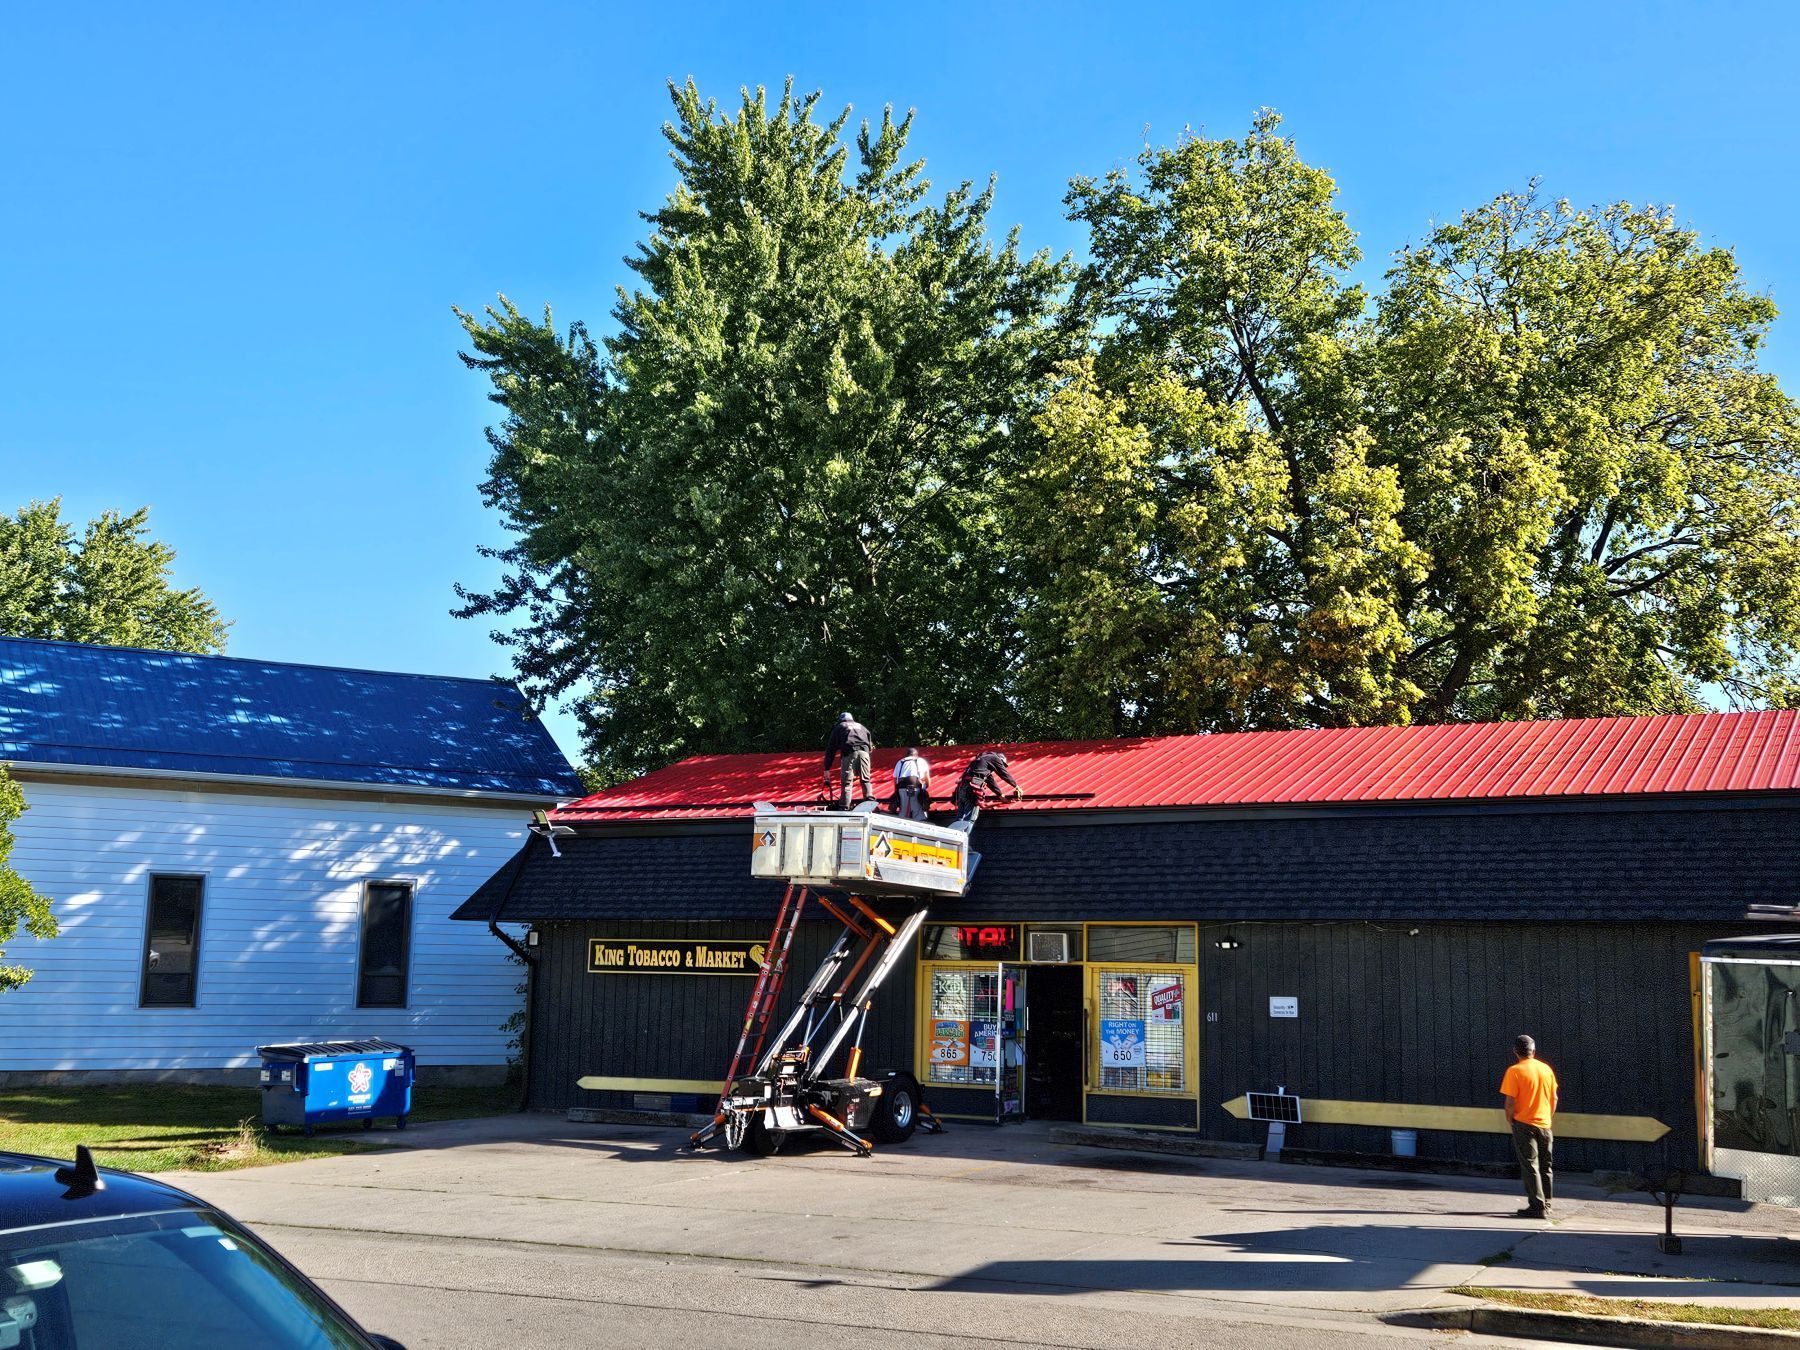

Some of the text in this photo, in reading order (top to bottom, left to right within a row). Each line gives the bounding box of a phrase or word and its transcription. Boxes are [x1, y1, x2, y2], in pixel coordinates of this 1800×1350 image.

[627, 945, 680, 967] TOBACCO
[685, 951, 693, 967] &
[695, 946, 746, 968] MARKET
[1206, 1012, 1218, 1022] 611
[974, 1030, 998, 1038] AMERIC
[940, 1048, 957, 1059] 865
[1113, 1050, 1132, 1061] 650
